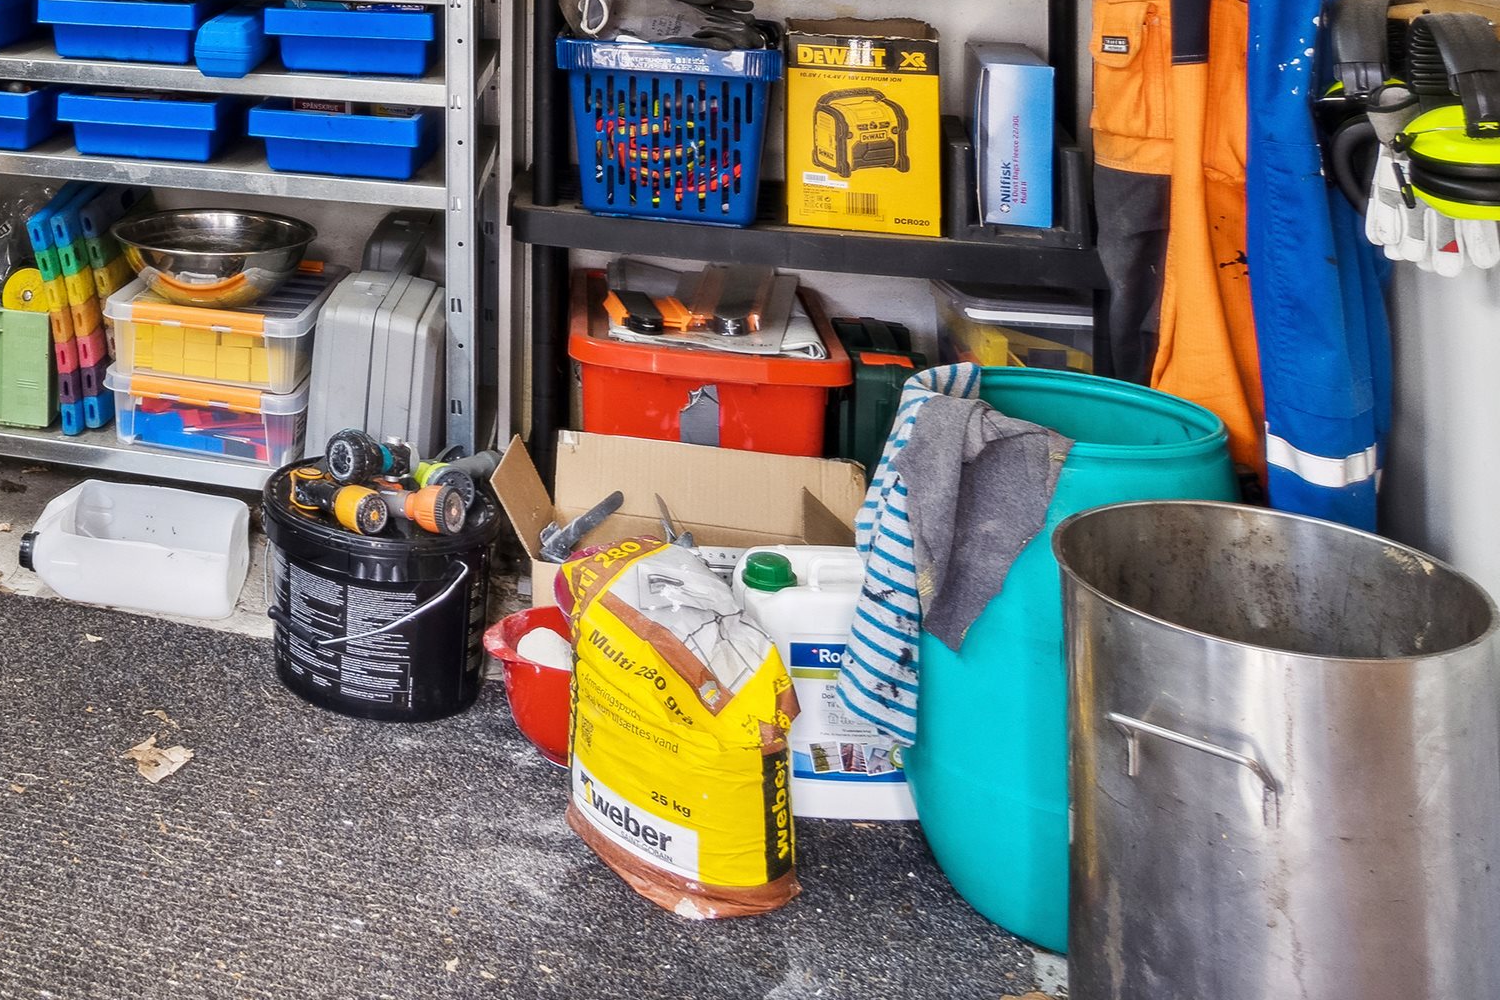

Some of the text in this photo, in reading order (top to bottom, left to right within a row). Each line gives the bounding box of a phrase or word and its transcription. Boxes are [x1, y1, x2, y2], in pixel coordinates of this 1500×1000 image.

[900, 51, 927, 67] XR
[1000, 161, 1012, 203] Nilfisk
[893, 217, 931, 227] DCR020
[593, 541, 641, 569] 280
[588, 628, 637, 671] Multi
[633, 665, 667, 691] 280
[819, 648, 841, 664] Ro
[652, 734, 679, 754] vand
[650, 790, 692, 818] 25 kg
[772, 759, 790, 861] weber
[590, 786, 673, 852] weber
[620, 829, 674, 864] SAINT-GOBAIN
